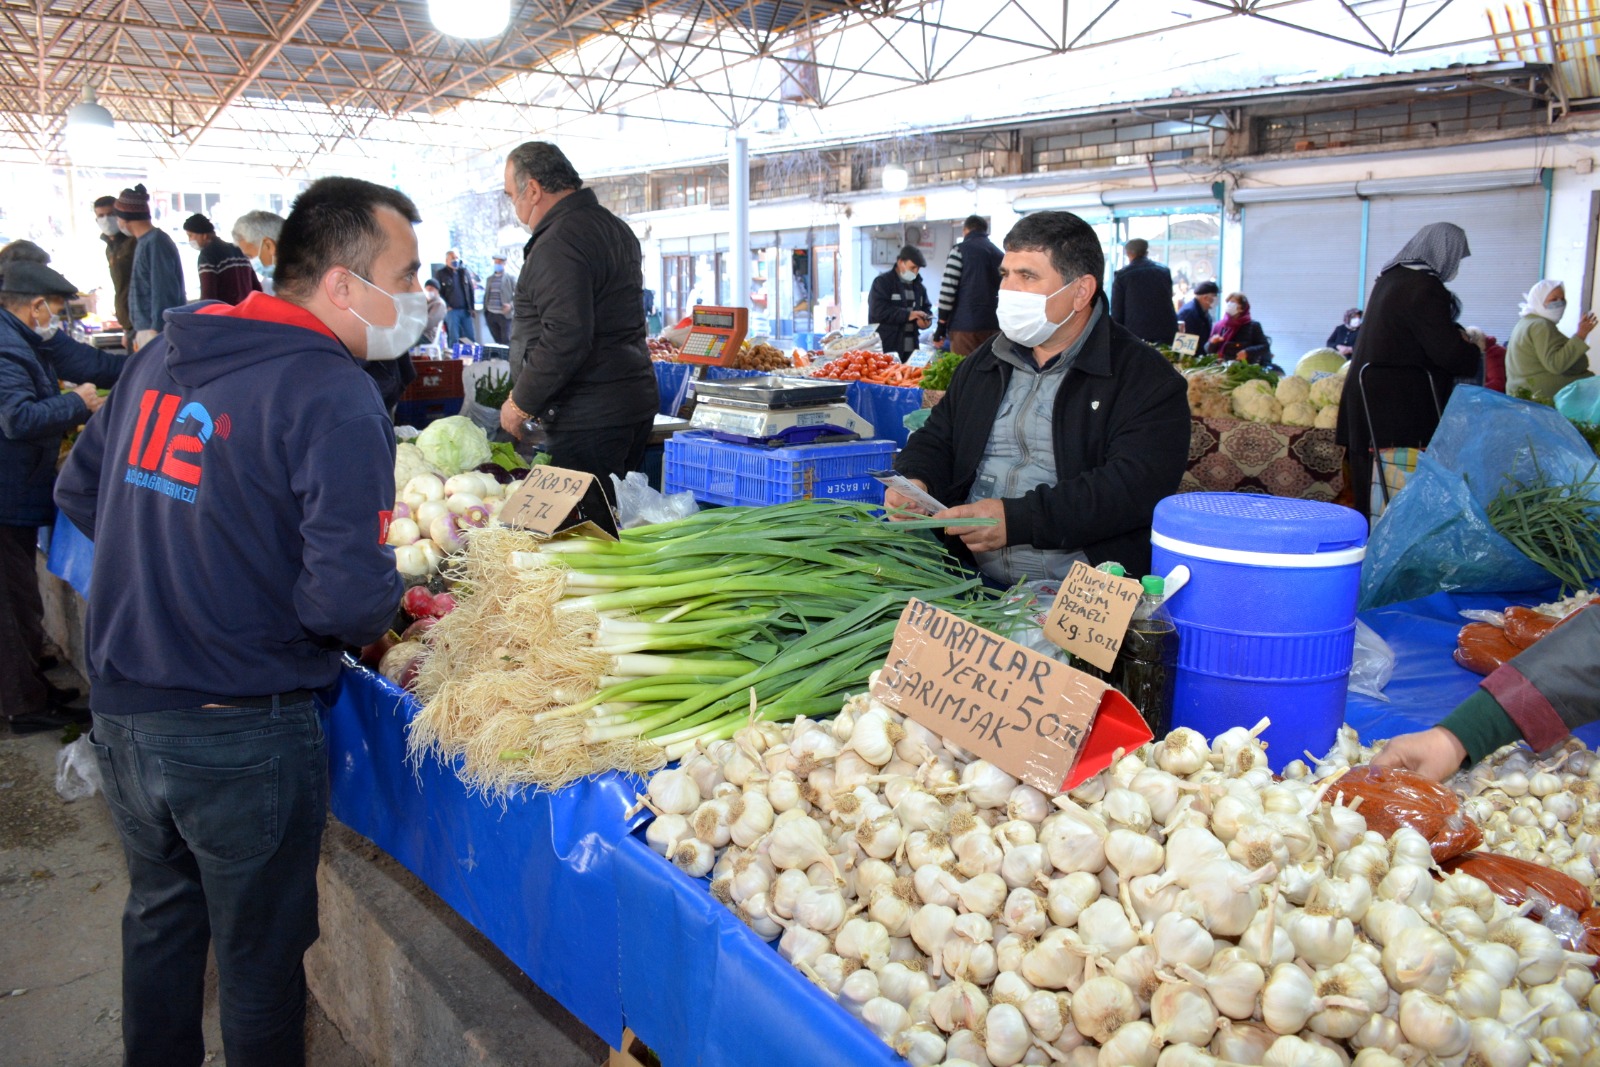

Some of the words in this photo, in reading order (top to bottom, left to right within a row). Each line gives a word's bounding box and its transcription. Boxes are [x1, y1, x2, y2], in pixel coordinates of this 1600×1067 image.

[128, 389, 213, 486] 112
[522, 468, 583, 496] PIRASA
[827, 482, 859, 494] BAŞER
[862, 482, 870, 491] M
[907, 600, 1050, 694] MURATLAR
[886, 659, 1011, 748] SARIMSAK
